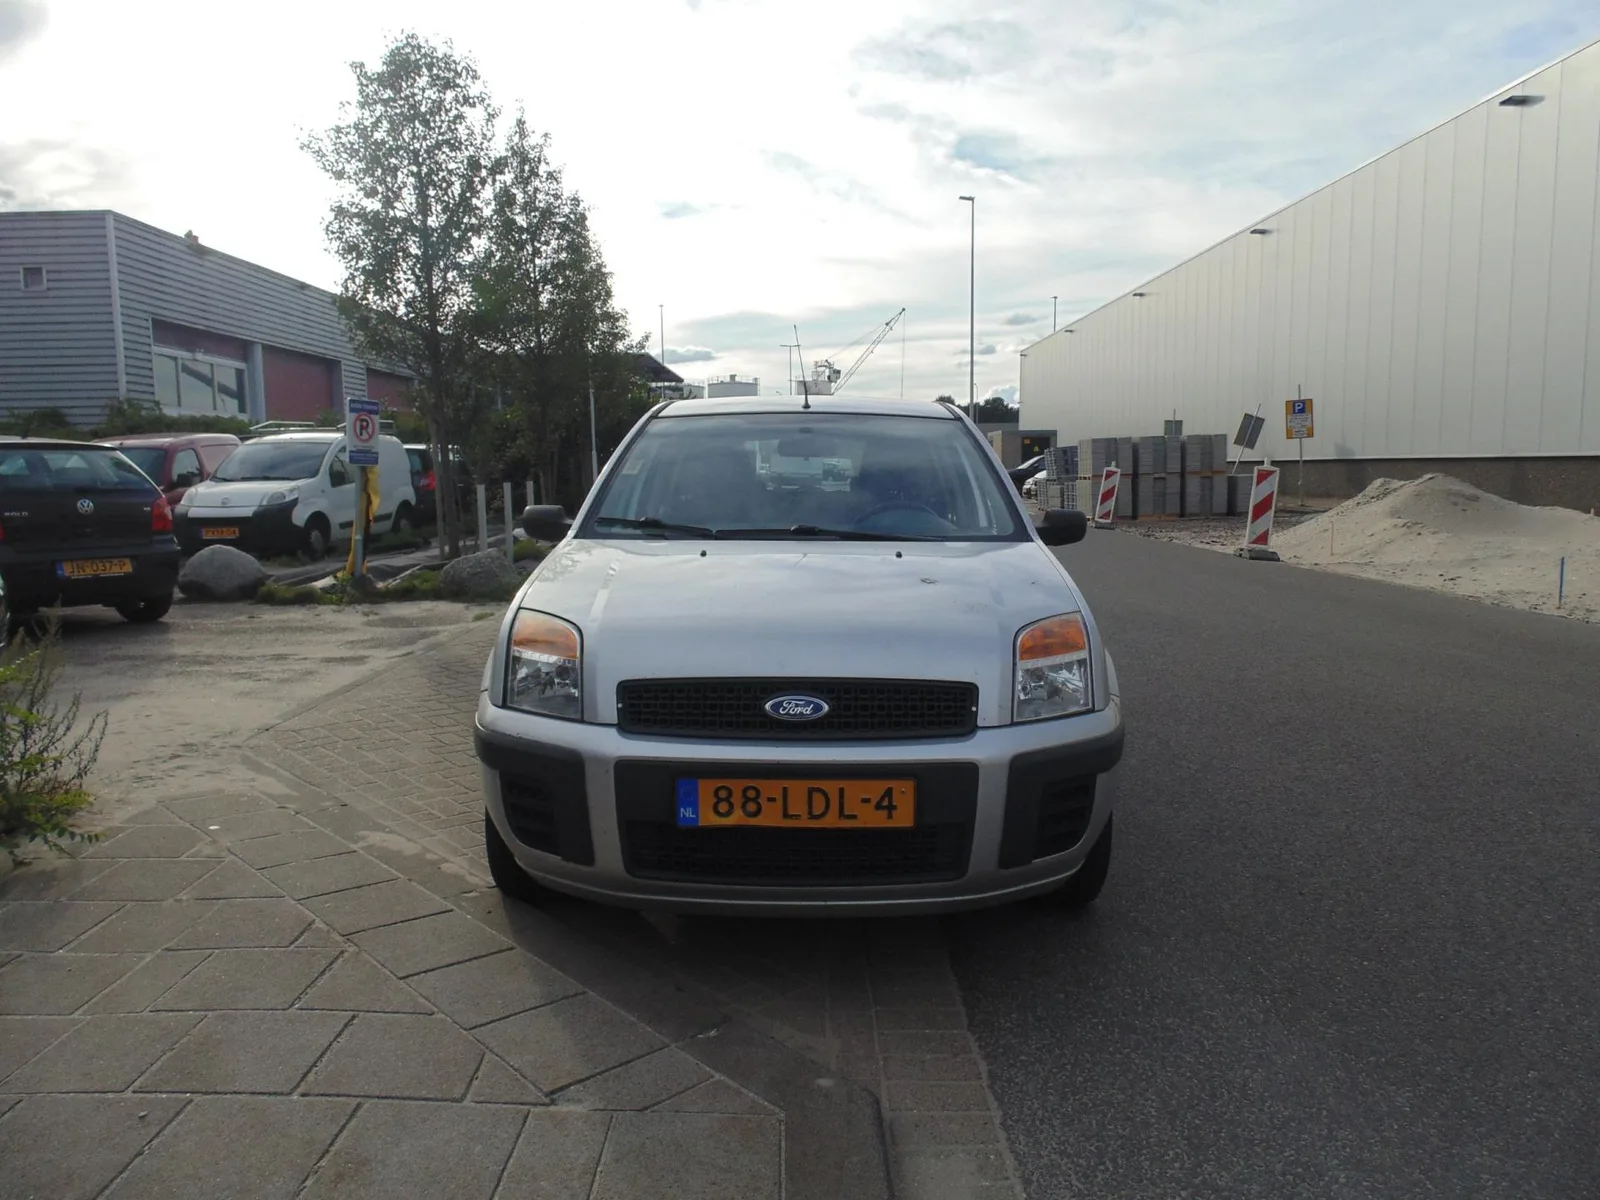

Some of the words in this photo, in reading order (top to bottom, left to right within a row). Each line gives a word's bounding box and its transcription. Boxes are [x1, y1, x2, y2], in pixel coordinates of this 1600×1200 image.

[1295, 402, 1303, 413] P
[779, 699, 814, 716] Ford
[712, 785, 898, 821] 88-LDL-4
[680, 807, 696, 818] NL
